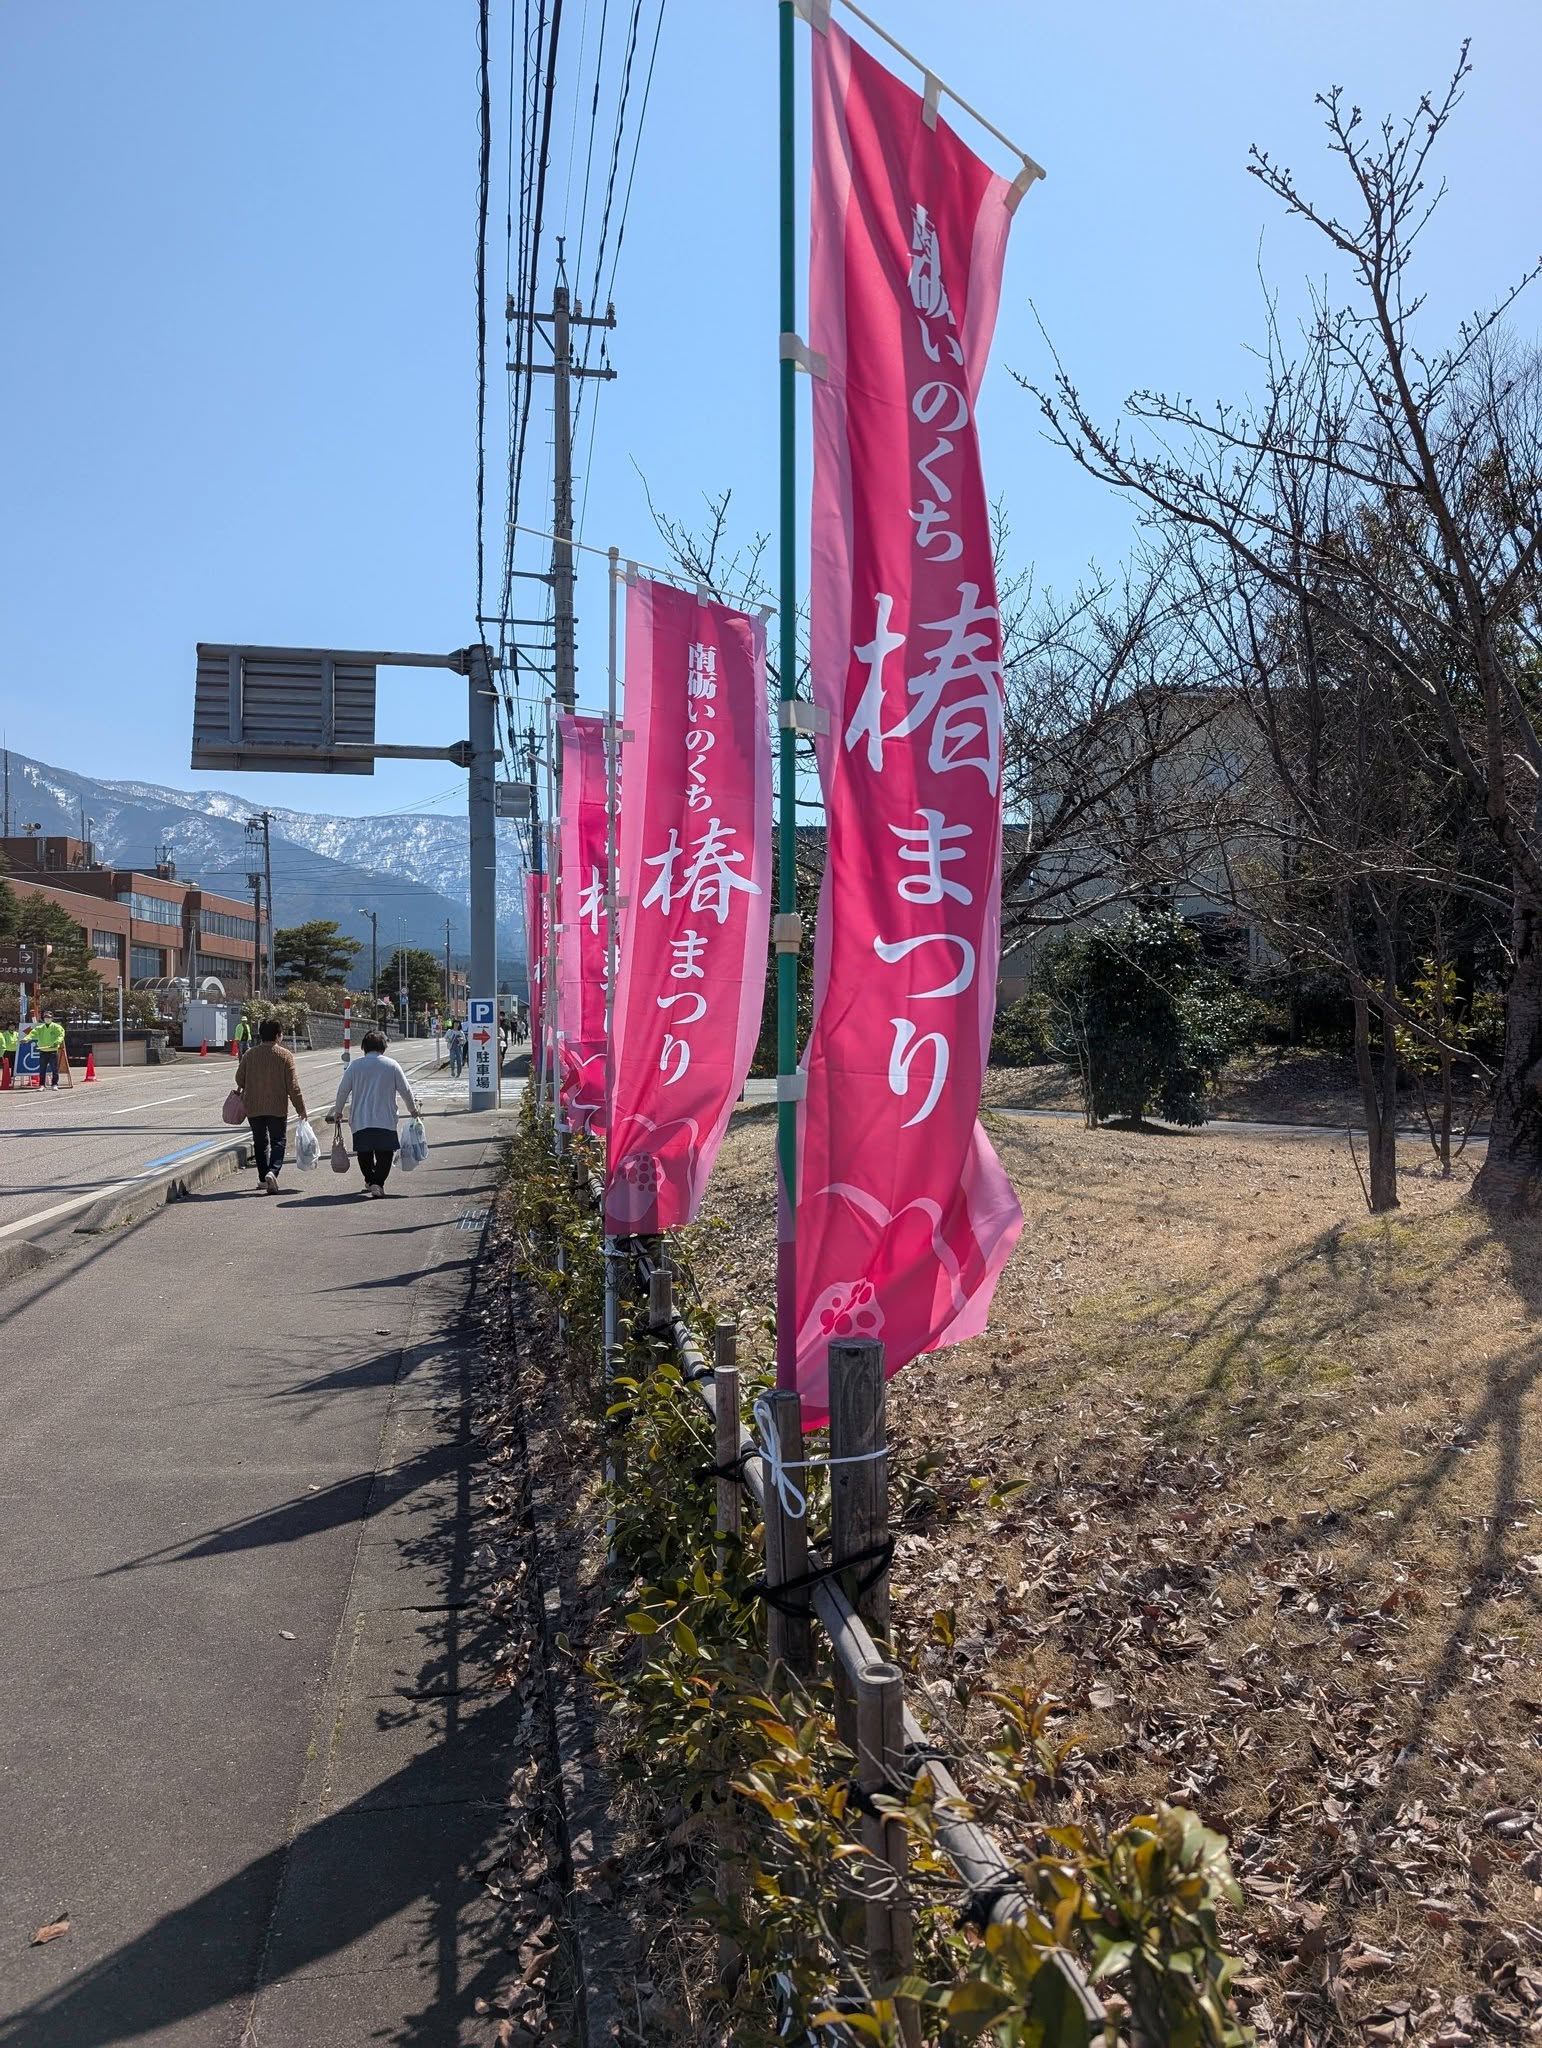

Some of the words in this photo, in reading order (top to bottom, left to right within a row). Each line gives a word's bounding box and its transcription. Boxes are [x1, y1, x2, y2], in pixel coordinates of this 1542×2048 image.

[476, 1004, 490, 1022] P
[475, 1051, 490, 1089] 駐車場
